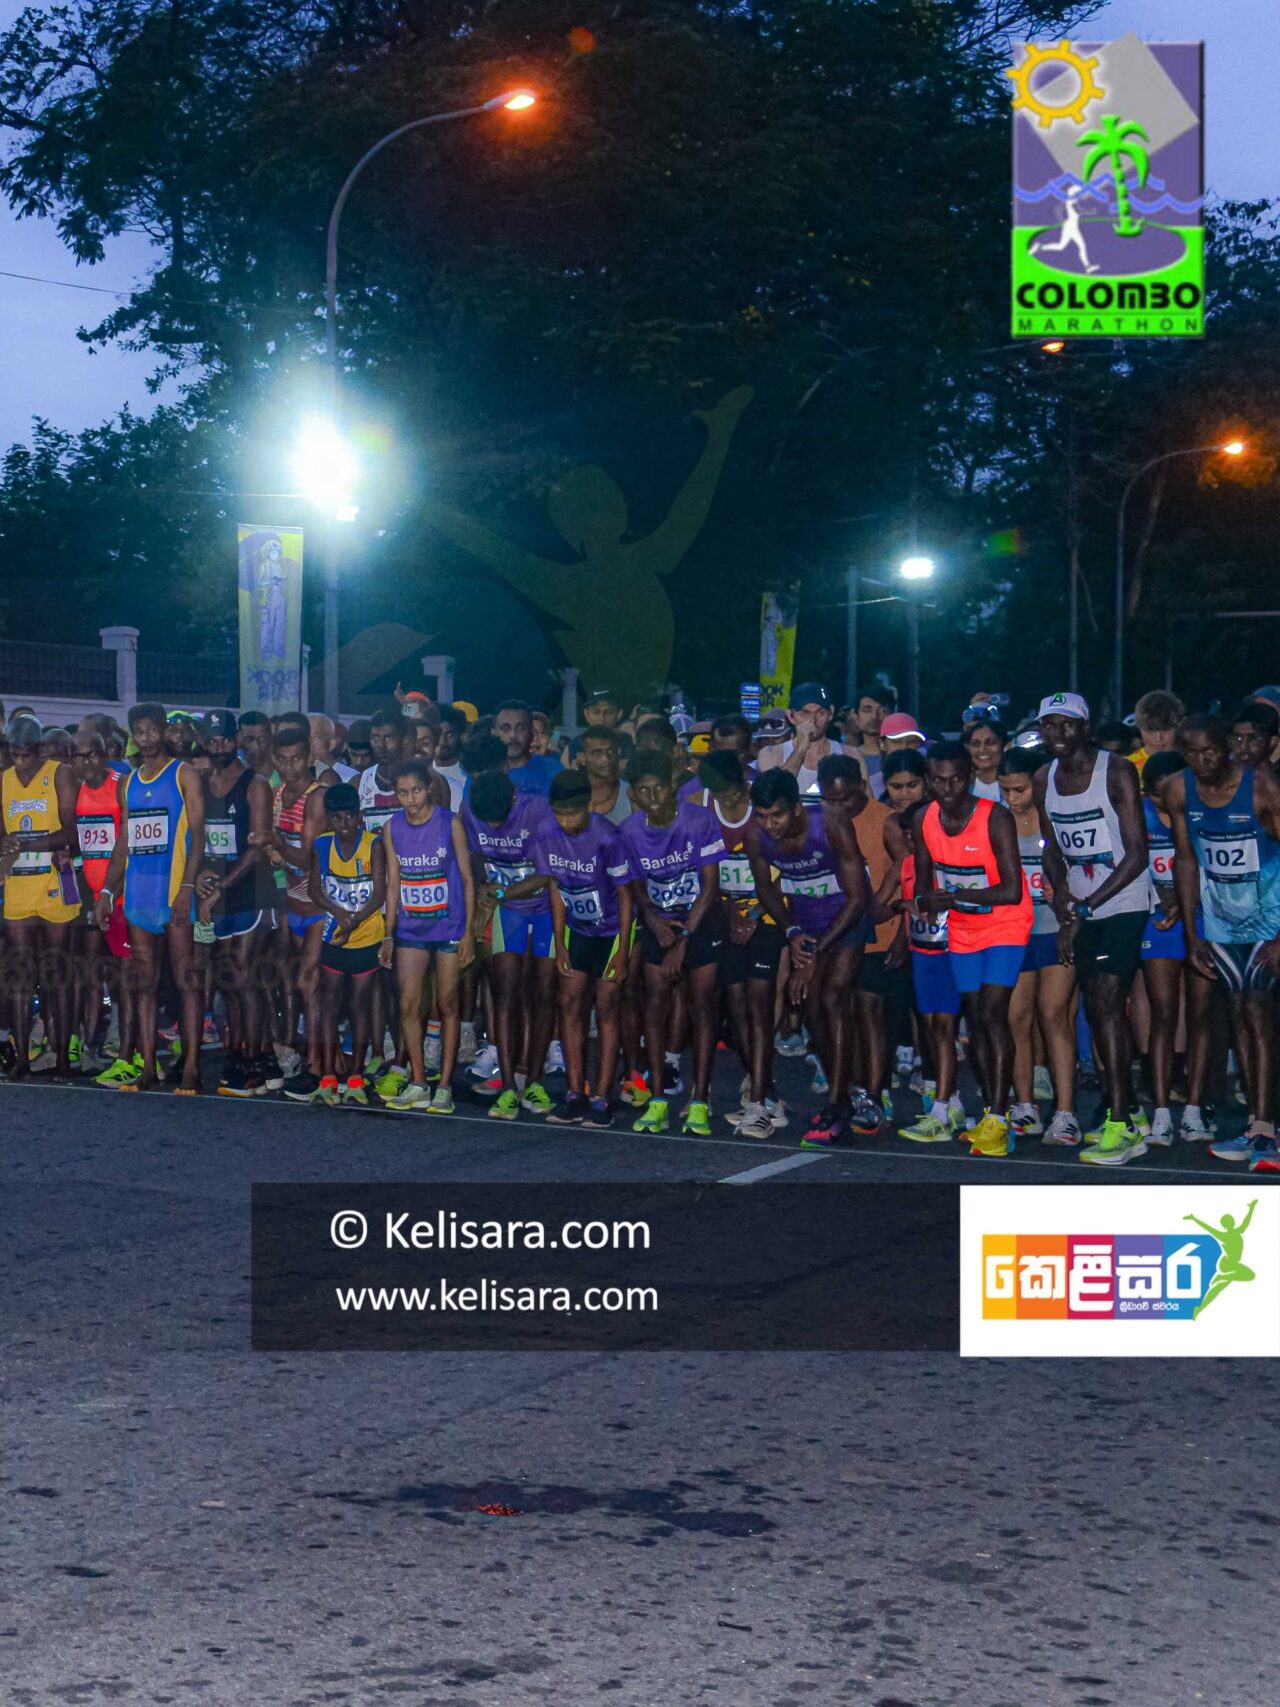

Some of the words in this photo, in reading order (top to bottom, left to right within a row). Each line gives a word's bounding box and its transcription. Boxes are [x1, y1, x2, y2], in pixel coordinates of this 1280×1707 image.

[136, 823, 162, 840] 806
[478, 832, 523, 848] Baraka
[1060, 828, 1096, 848] 067
[548, 854, 594, 873] Baraka
[640, 850, 689, 870] Baraka
[1204, 848, 1246, 867] 102
[721, 867, 754, 884] 512
[402, 886, 445, 904] 1580
[652, 879, 696, 902] 2062
